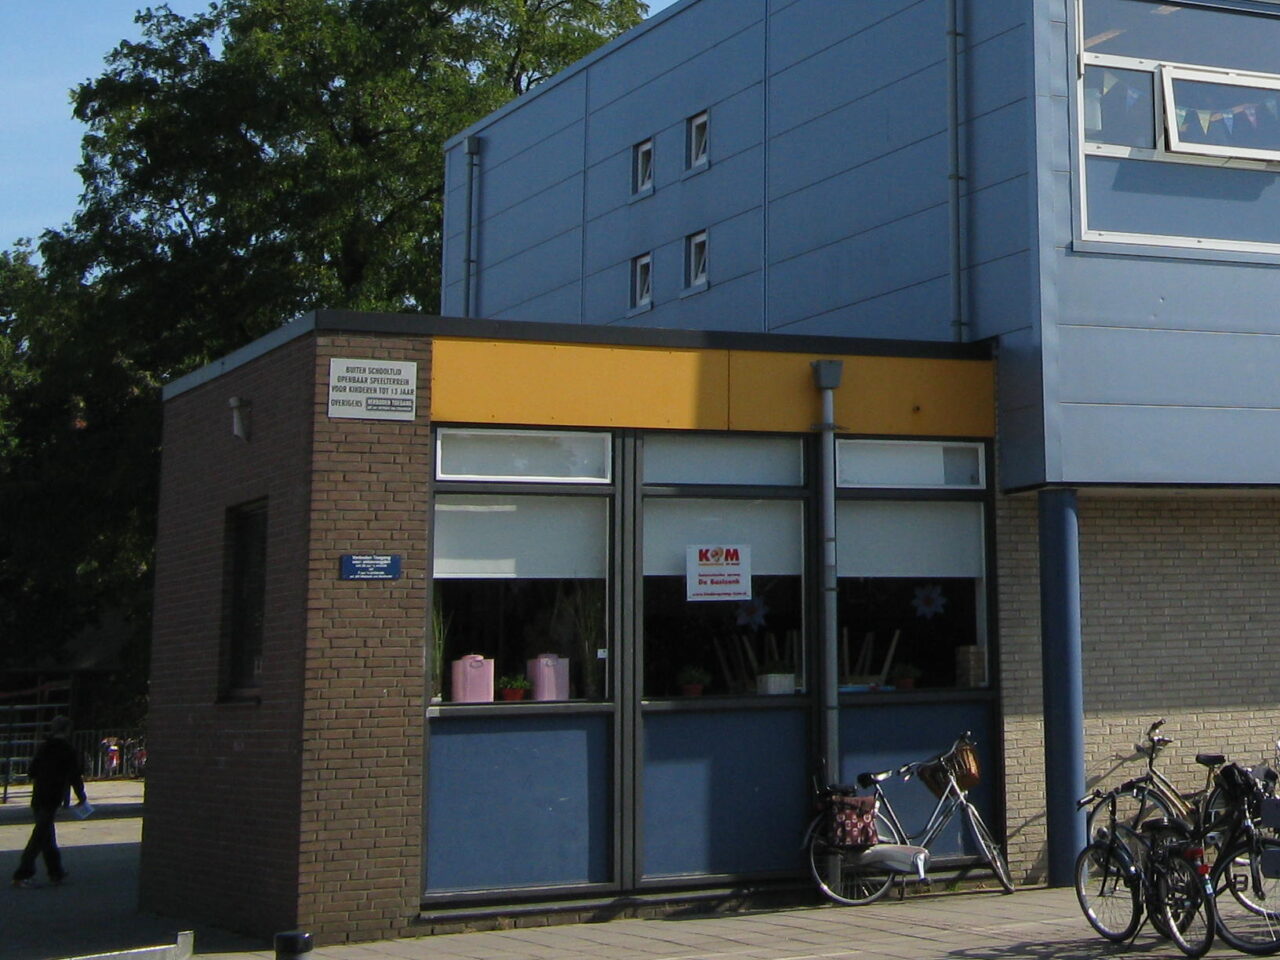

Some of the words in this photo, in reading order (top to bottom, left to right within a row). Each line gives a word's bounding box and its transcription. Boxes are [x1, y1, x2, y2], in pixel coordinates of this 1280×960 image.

[345, 366, 366, 374] BUITEN
[368, 367, 402, 376] SCHOOLTIJD
[337, 375, 368, 384] OPENBAAR
[369, 377, 410, 385] SPEELTERREIN
[331, 385, 347, 393] VOOR
[348, 386, 377, 394] KINDEREN
[379, 387, 389, 395] TOT
[400, 388, 414, 396] JAAR
[331, 399, 363, 408] OVERIGENS
